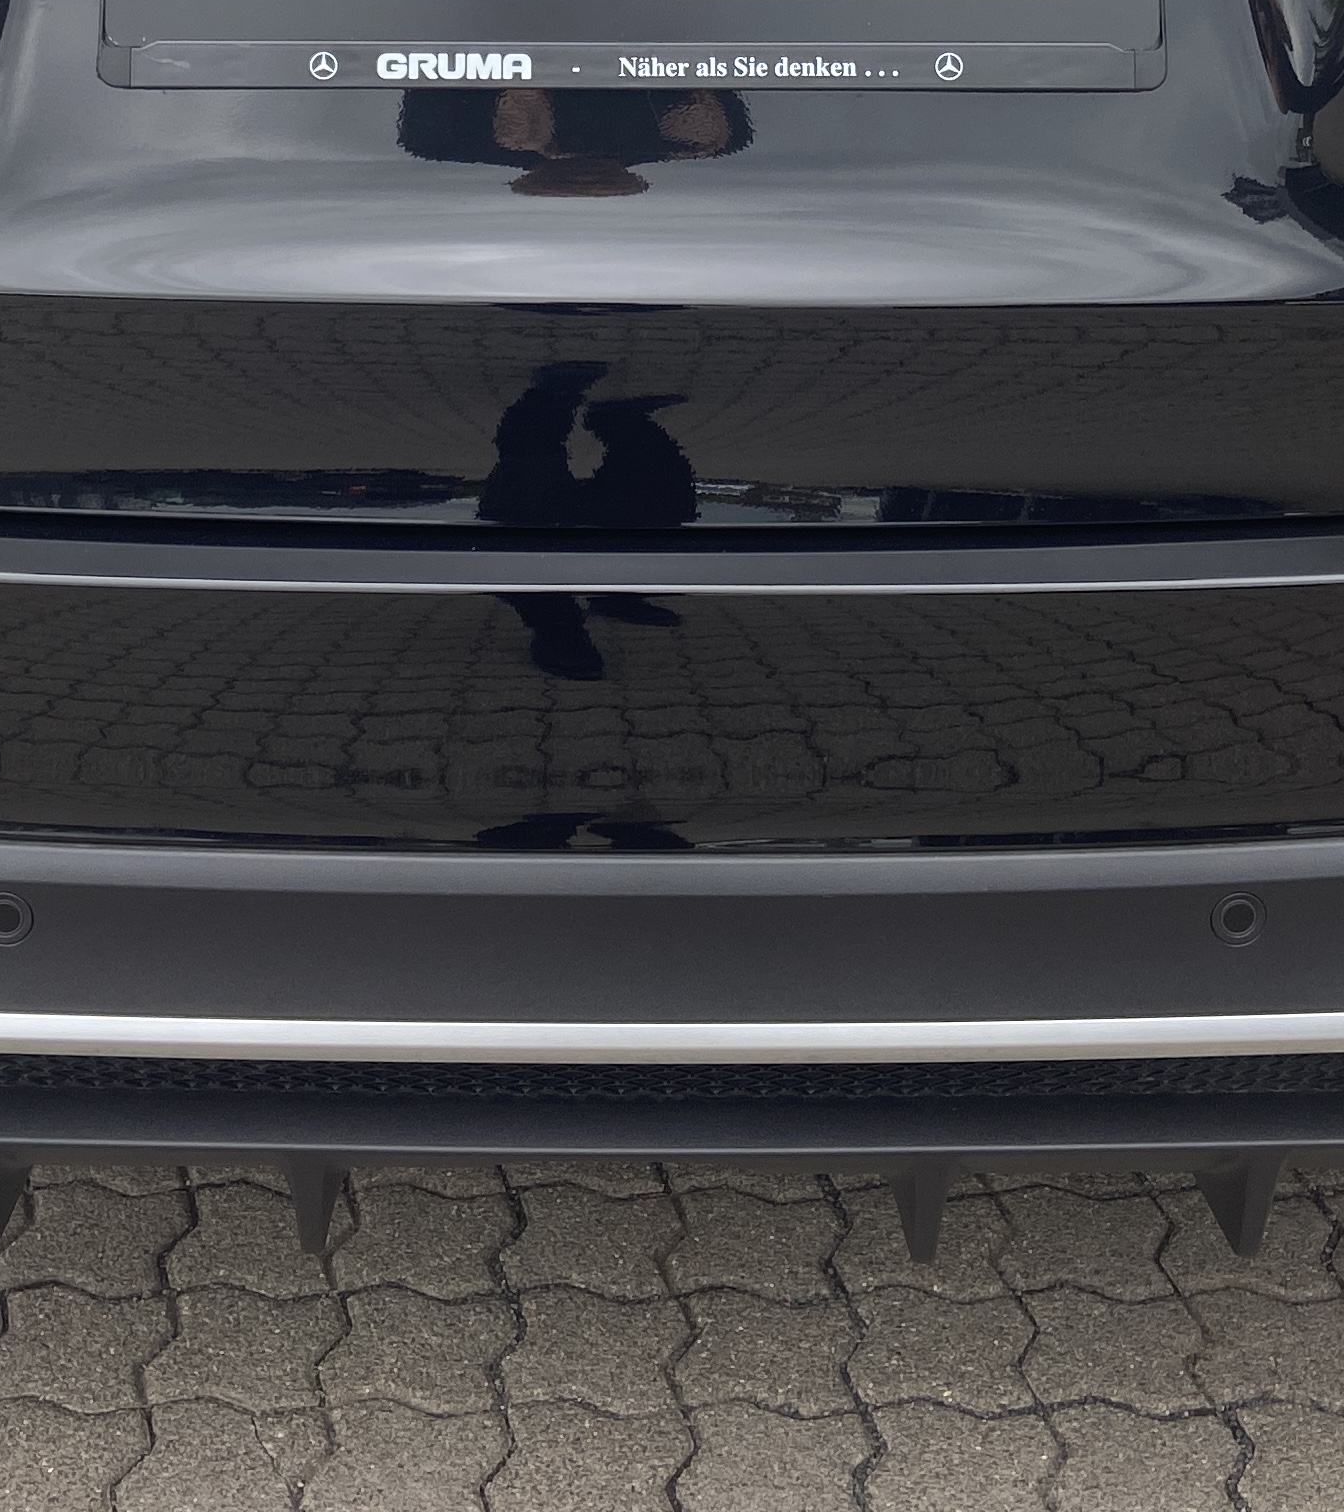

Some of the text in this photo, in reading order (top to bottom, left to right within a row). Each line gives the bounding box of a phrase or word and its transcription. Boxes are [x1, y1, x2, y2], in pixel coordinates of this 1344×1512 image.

[376, 52, 532, 80] GRUMA
[618, 56, 690, 77] Näher
[695, 56, 728, 77] als
[733, 56, 768, 77] Sie
[774, 56, 857, 77] denken
